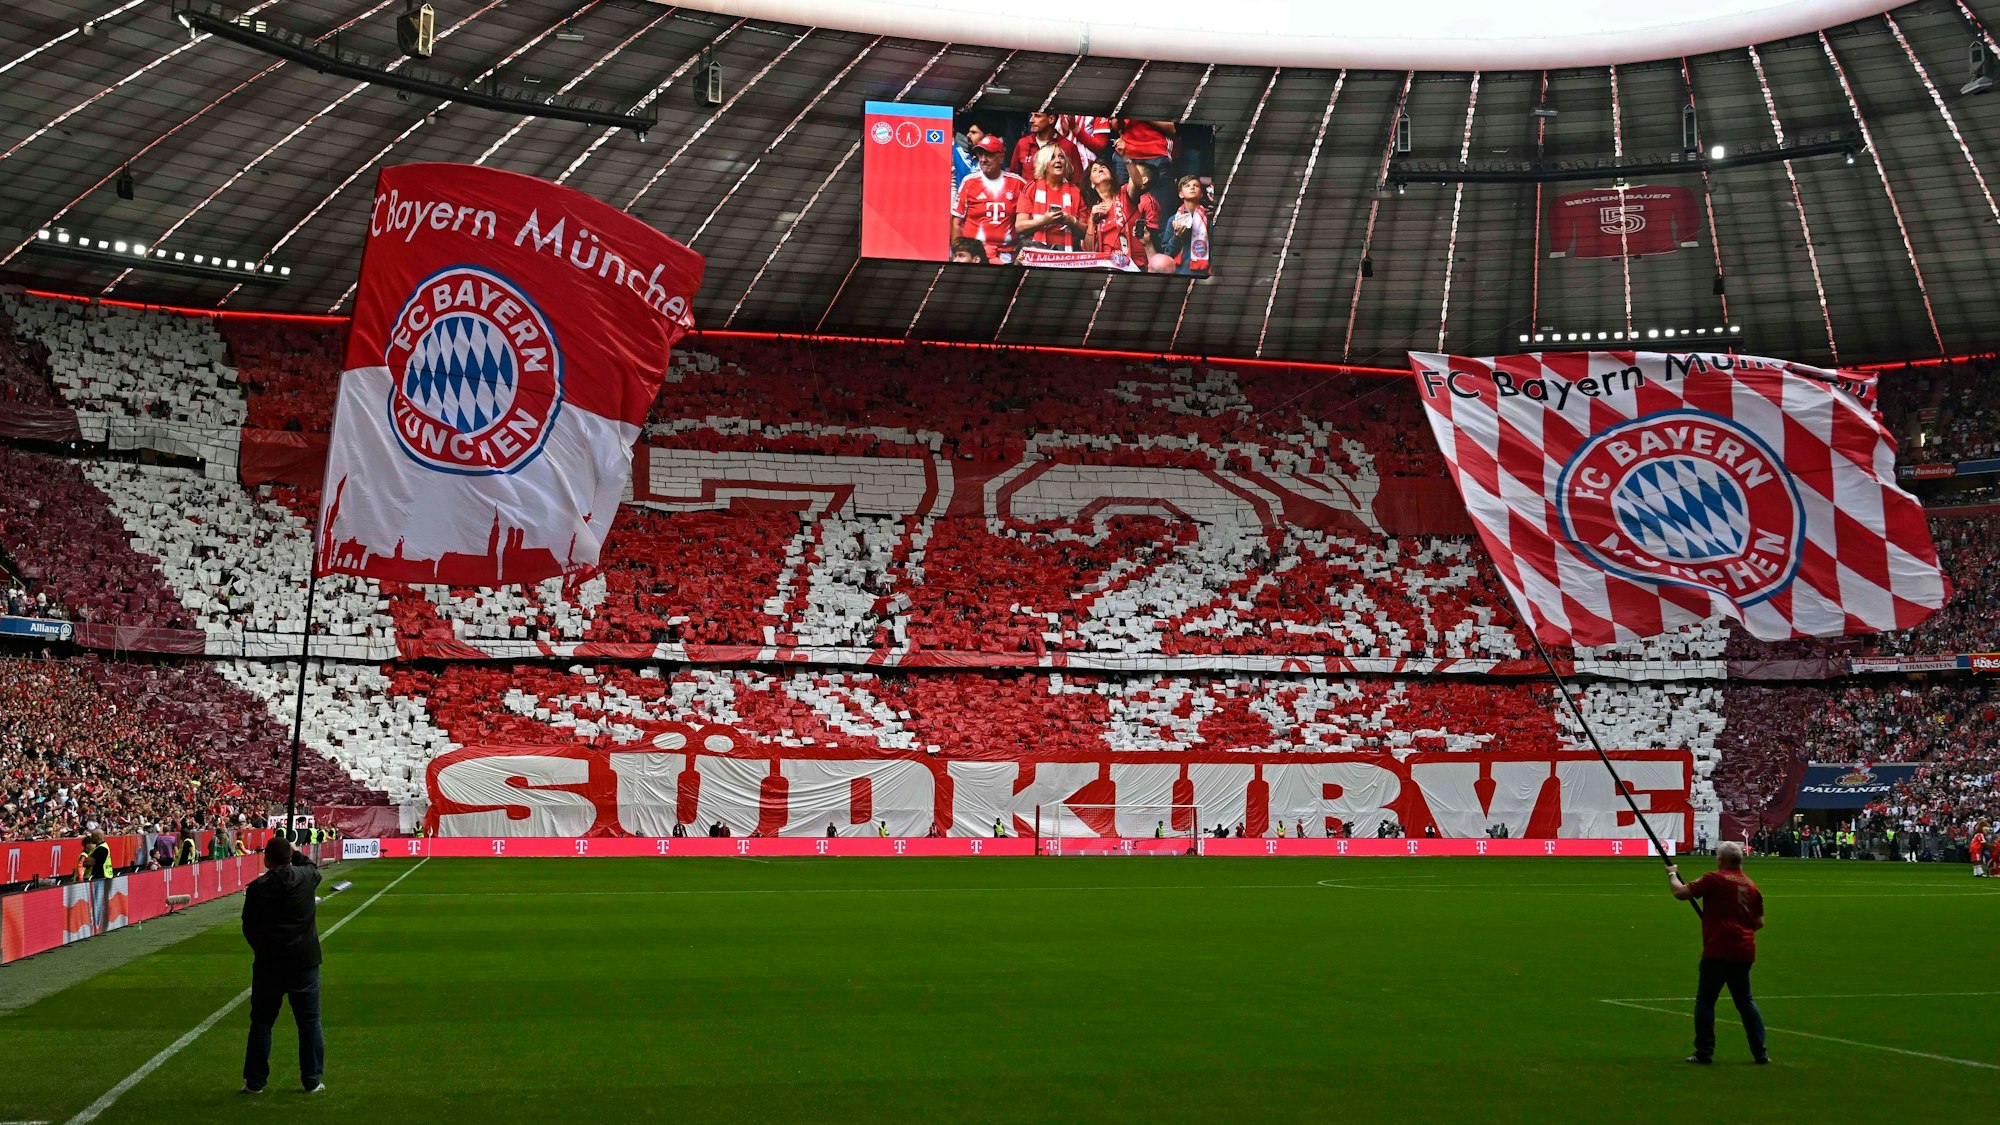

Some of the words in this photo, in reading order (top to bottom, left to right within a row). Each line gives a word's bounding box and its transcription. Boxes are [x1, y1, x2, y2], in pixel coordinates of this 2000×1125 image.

[1564, 192, 1671, 206] BECKENBAUER
[371, 193, 387, 238] C
[386, 189, 497, 243] Bayern
[1599, 205, 1646, 235] 5
[394, 304, 430, 352] FC
[432, 278, 549, 373] BAYERN
[1421, 369, 1481, 400] FC
[1490, 363, 1645, 411] Bayern
[1574, 467, 1612, 501] FC
[1606, 425, 1774, 490] BAYERN
[30, 623, 60, 634] Allianz
[1905, 662, 1953, 670] TRAUNSTEIN
[437, 731, 1685, 838] SÜDKURVE
[1801, 785, 1891, 794] PAULANER
[344, 843, 369, 855] Allianz
